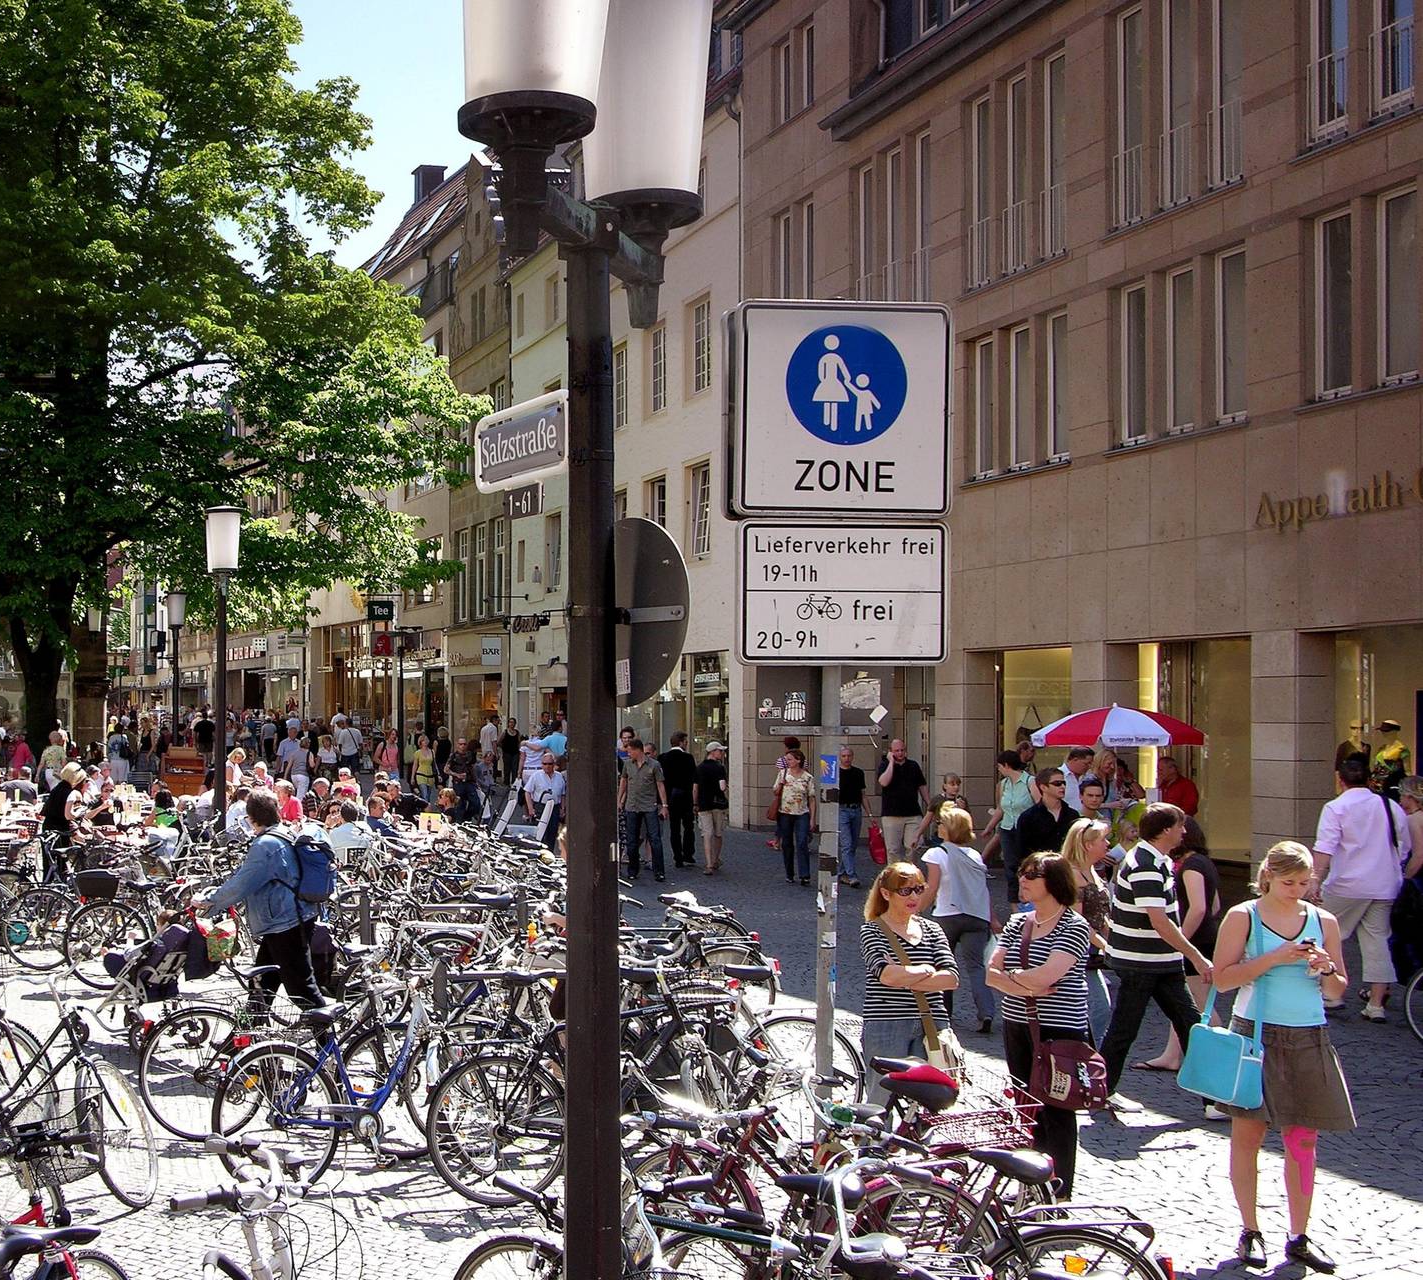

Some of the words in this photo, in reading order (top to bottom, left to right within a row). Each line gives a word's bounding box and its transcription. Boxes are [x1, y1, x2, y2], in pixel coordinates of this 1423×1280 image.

[481, 418, 557, 469] Salzstraße
[794, 459, 895, 493] ZONE
[754, 535, 891, 554] Lieferverkehr
[902, 537, 935, 555] frei
[762, 564, 818, 582] 19-11h
[372, 605, 389, 616] Tee
[852, 599, 894, 621] frei
[757, 630, 818, 649] 20-9h
